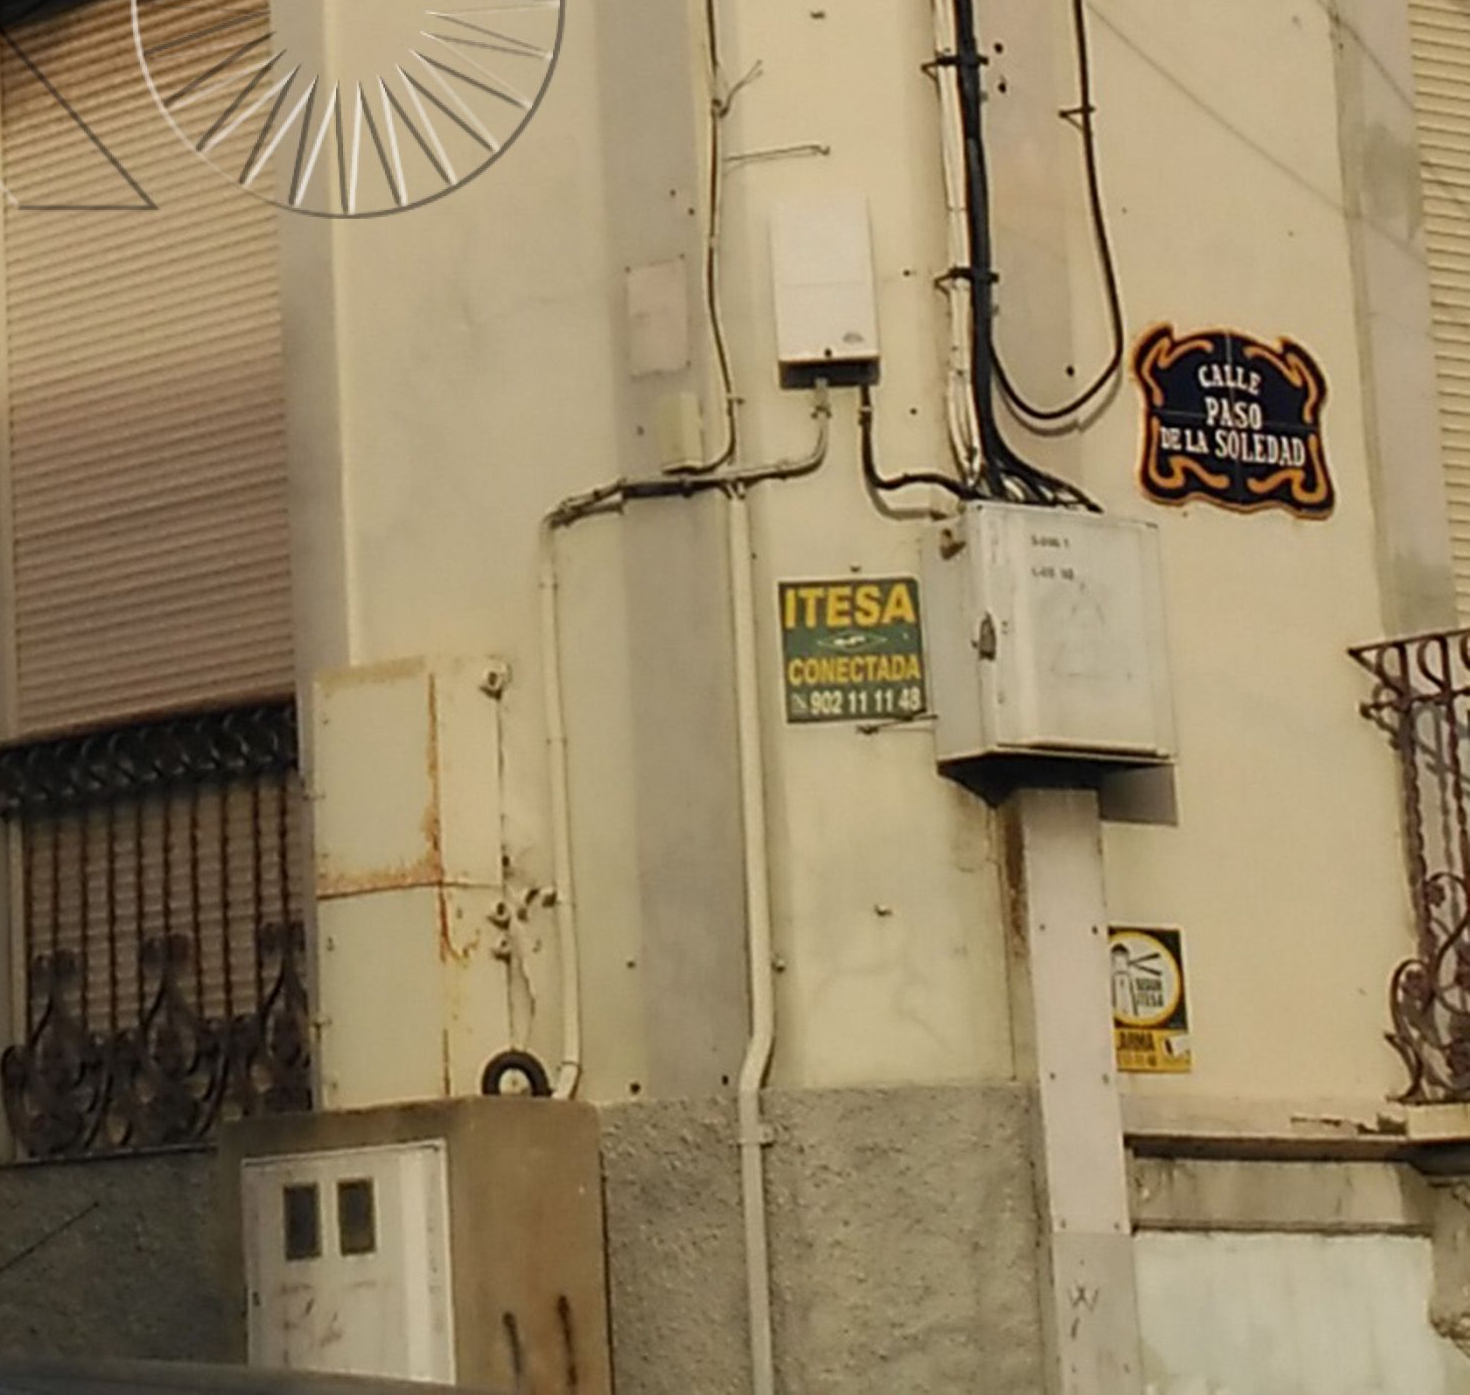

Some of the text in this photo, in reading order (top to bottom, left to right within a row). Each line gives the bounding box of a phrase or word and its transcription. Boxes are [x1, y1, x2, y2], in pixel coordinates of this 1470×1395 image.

[1198, 363, 1261, 395] CALLE
[1204, 396, 1262, 430] PASO
[1160, 427, 1306, 466] DE LA SOLEDAD
[785, 582, 916, 629] ITESA
[788, 655, 922, 685] CONECTADA
[810, 690, 843, 715] 902
[848, 690, 868, 713] 11
[874, 688, 893, 713] 11
